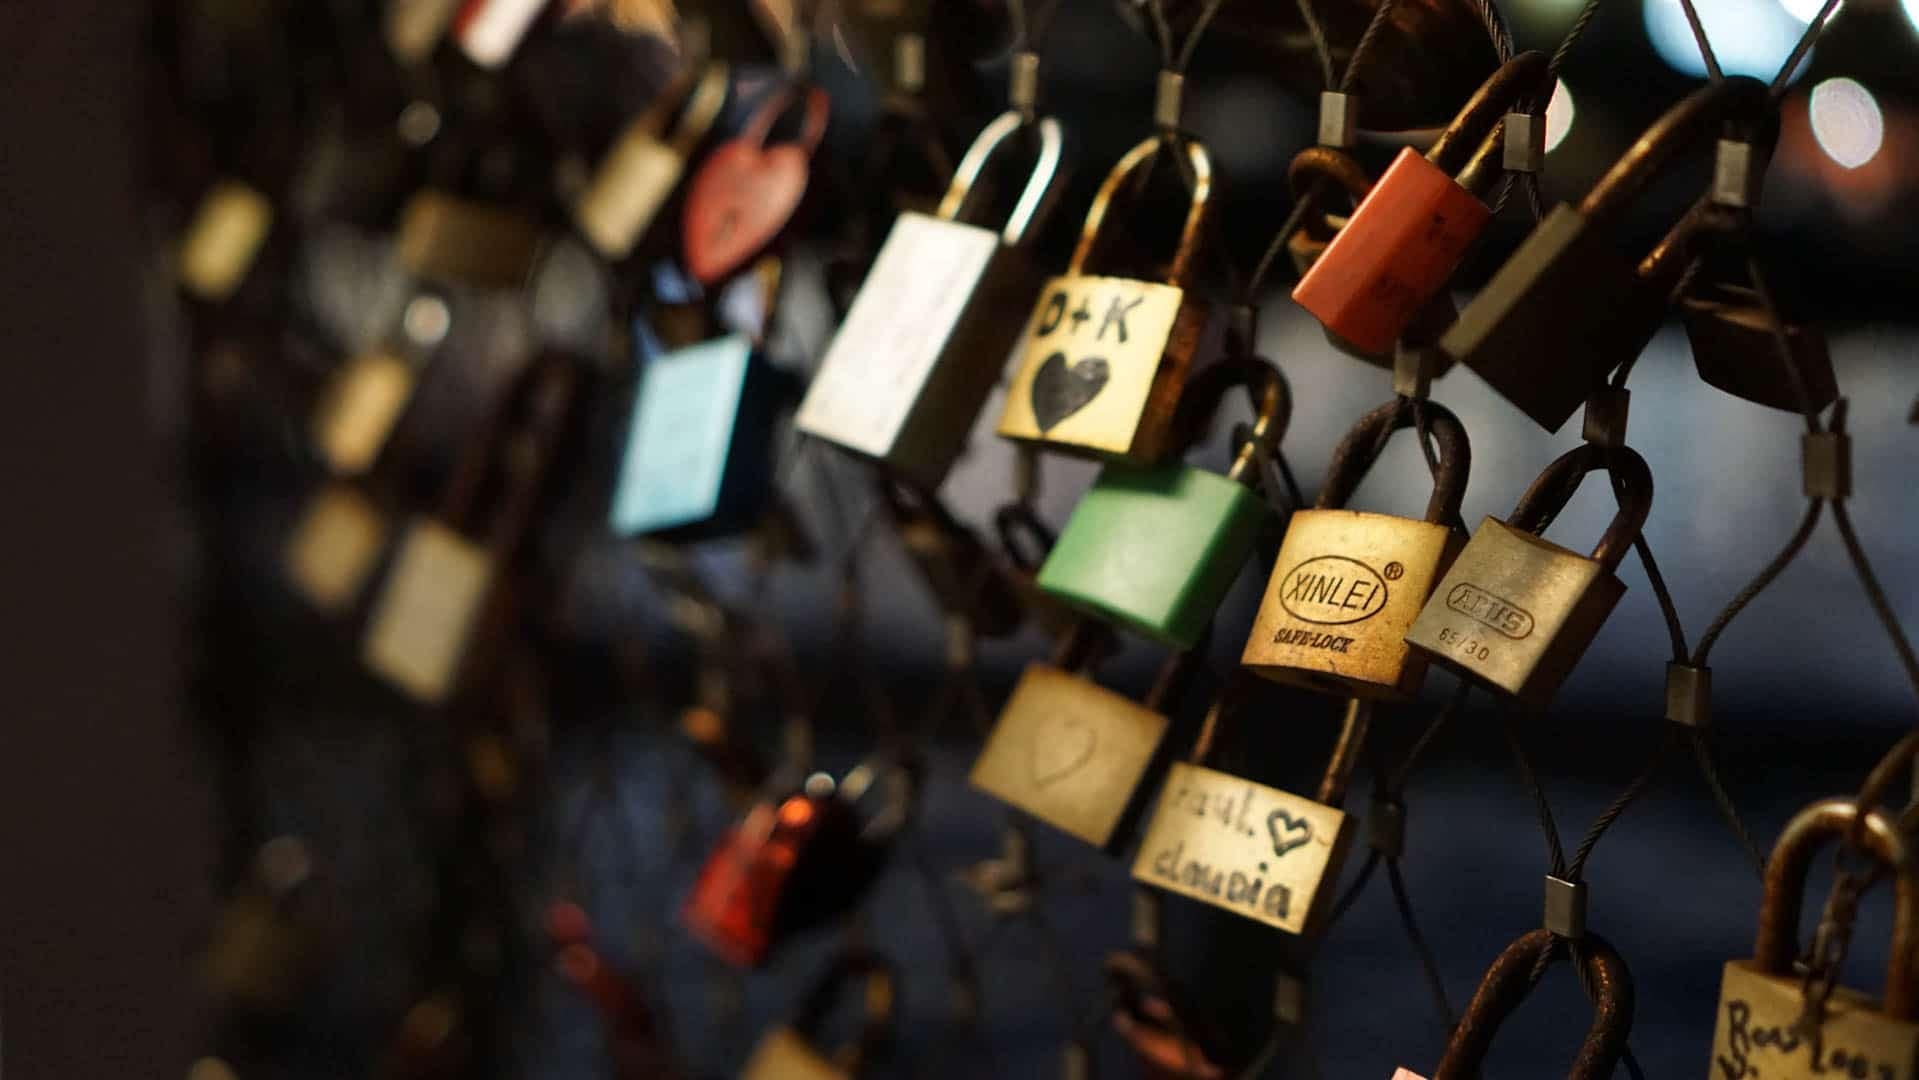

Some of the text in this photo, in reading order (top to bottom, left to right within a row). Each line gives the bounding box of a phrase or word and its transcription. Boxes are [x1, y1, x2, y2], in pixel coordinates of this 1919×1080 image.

[1035, 290, 1145, 344] D+K
[1284, 572, 1380, 611] XINLEI
[1273, 627, 1355, 654] SAFE-LOCK
[1438, 626, 1490, 662] 65/30
